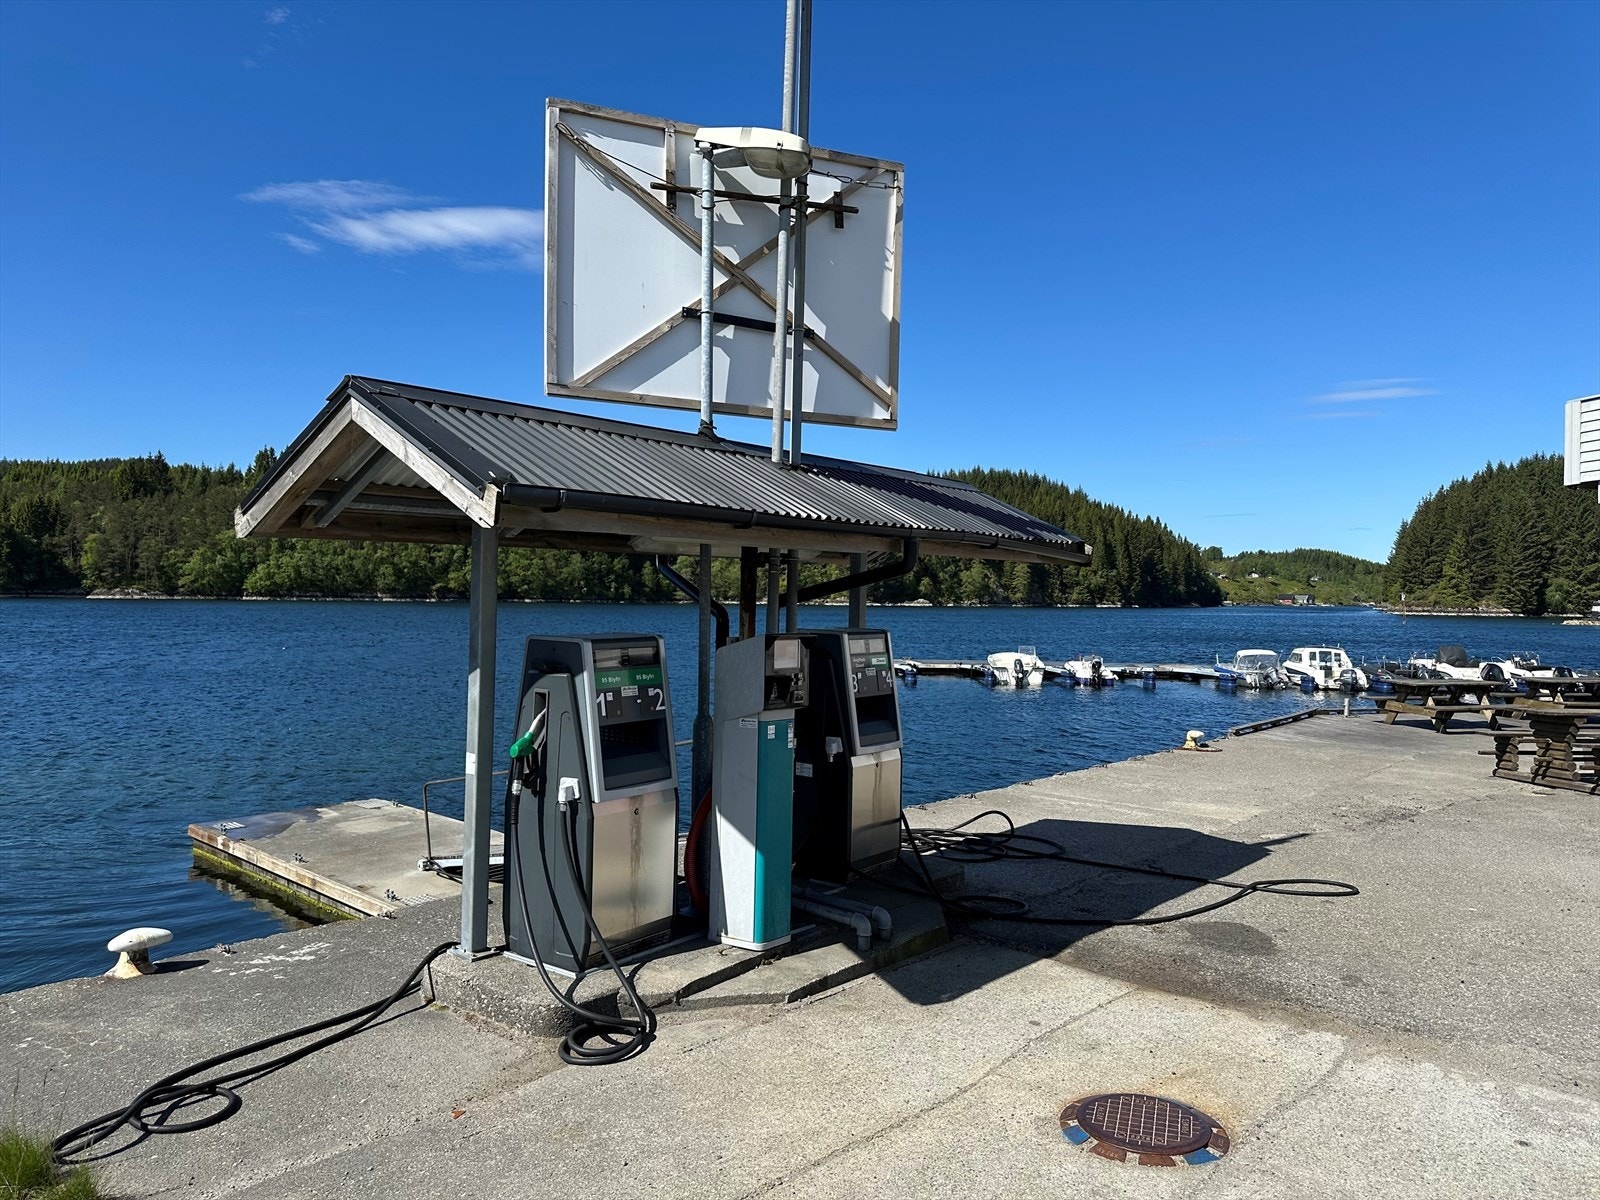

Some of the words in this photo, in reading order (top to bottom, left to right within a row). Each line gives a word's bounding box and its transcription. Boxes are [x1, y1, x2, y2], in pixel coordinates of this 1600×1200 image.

[851, 674, 858, 692] 3
[886, 670, 892, 687] 4
[596, 692, 606, 716] 1
[653, 688, 666, 711] 2
